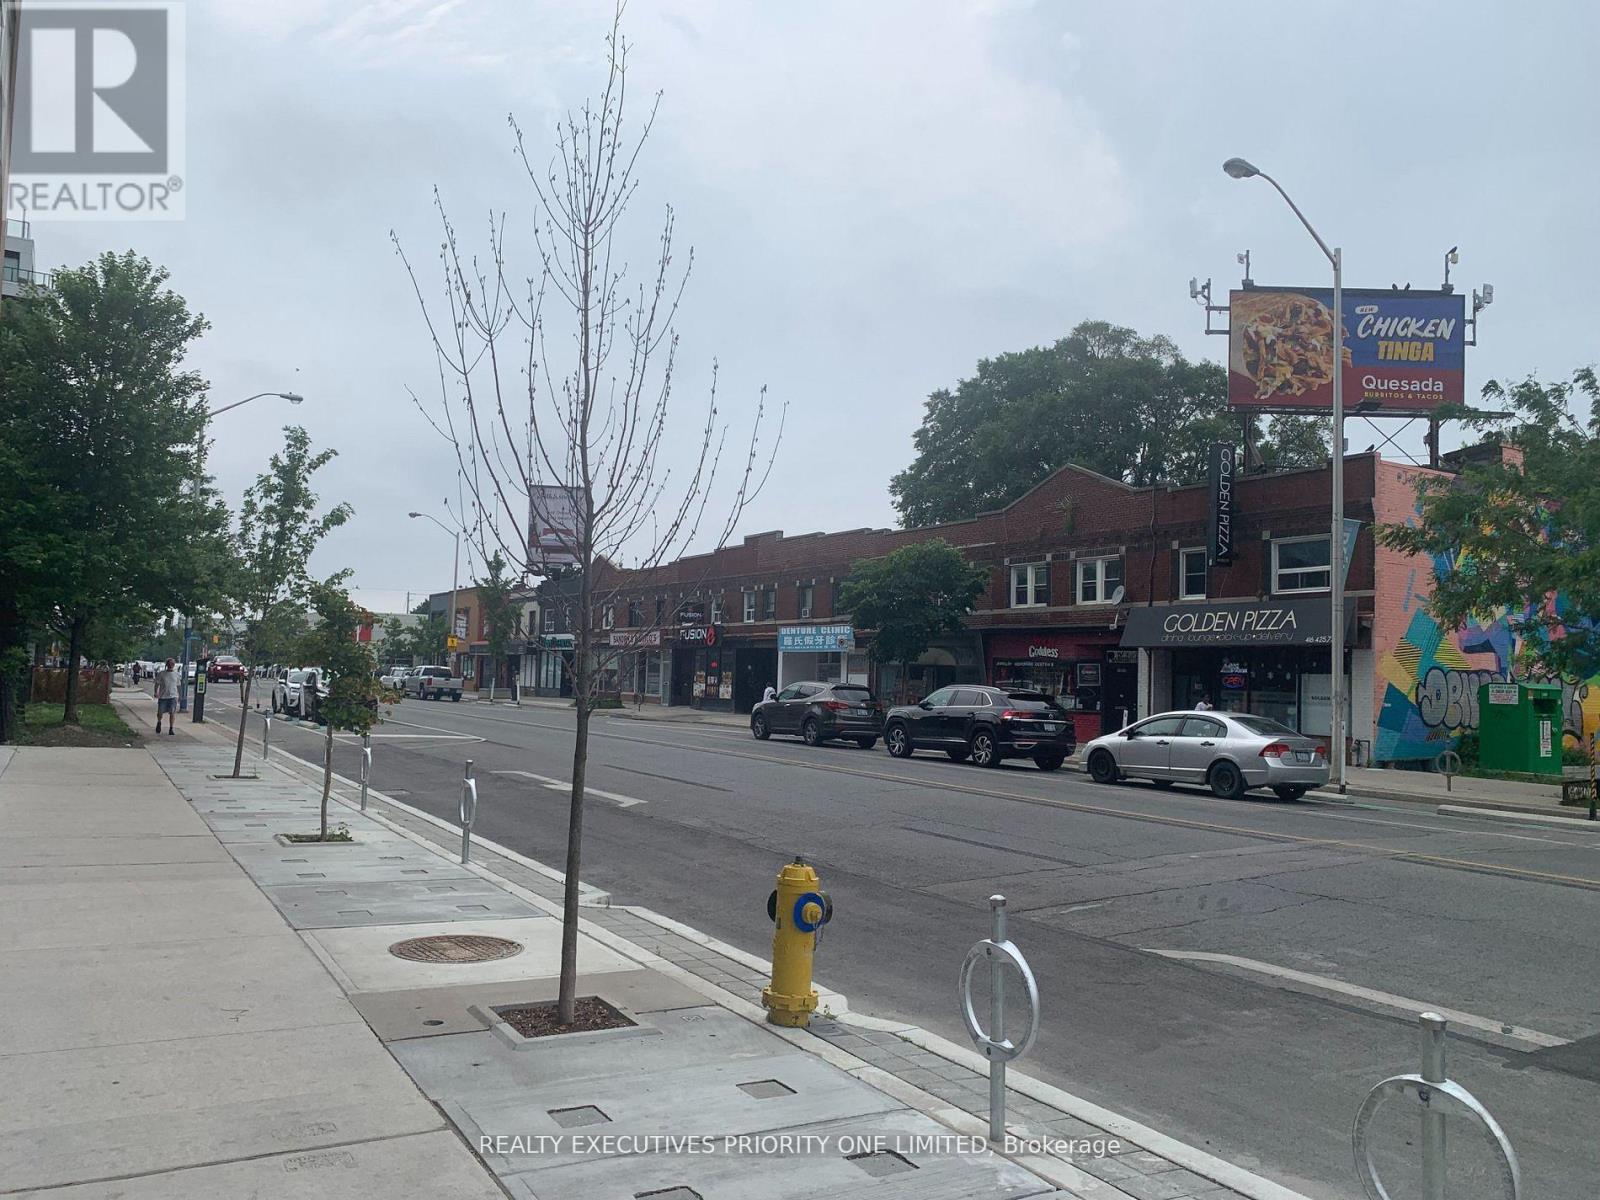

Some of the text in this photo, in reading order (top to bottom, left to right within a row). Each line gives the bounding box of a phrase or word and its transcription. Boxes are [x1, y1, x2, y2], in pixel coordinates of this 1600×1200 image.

[1357, 314, 1456, 340] CHICKEN
[1378, 341, 1435, 361] TINGA
[1362, 375, 1444, 392] Quesada
[1218, 448, 1231, 556] GOLDEN PIZZA
[1164, 609, 1297, 633] GOLDEN PIZZA
[680, 629, 707, 641] FUSION
[781, 626, 851, 635] DENTURE CLINIC
[1028, 645, 1059, 658] Goddess
